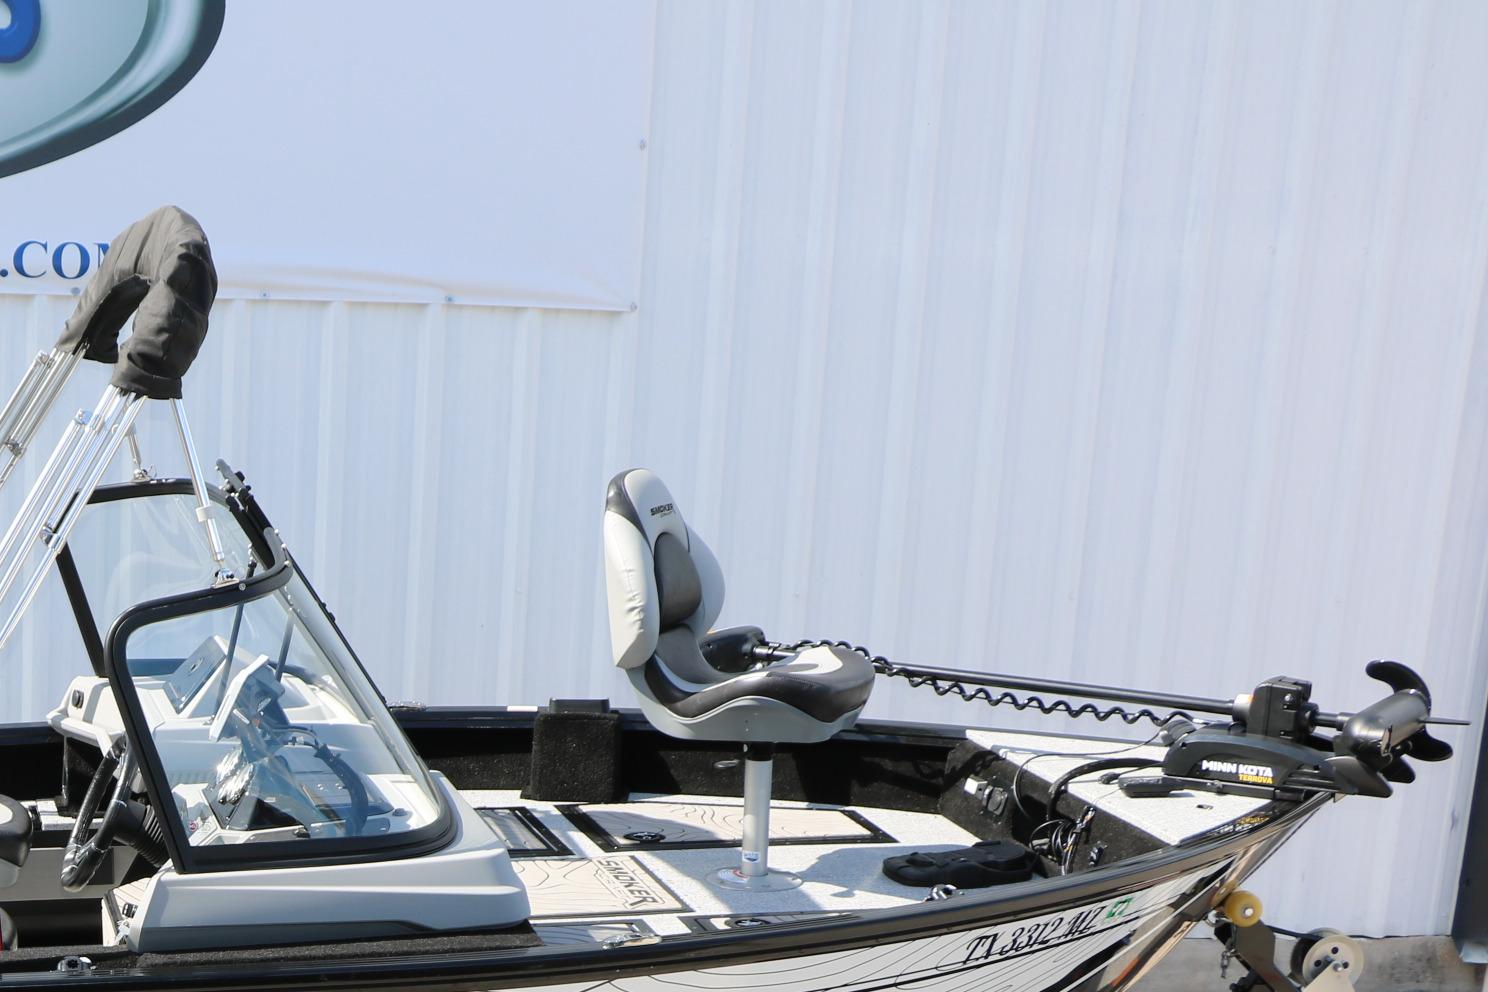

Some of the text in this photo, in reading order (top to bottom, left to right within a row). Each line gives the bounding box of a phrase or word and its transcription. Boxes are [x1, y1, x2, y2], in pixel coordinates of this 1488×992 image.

[1202, 760, 1273, 777] MINN KOTA
[1238, 774, 1273, 784] TERROVA
[596, 860, 659, 907] SMOKER
[963, 931, 1003, 964] TX
